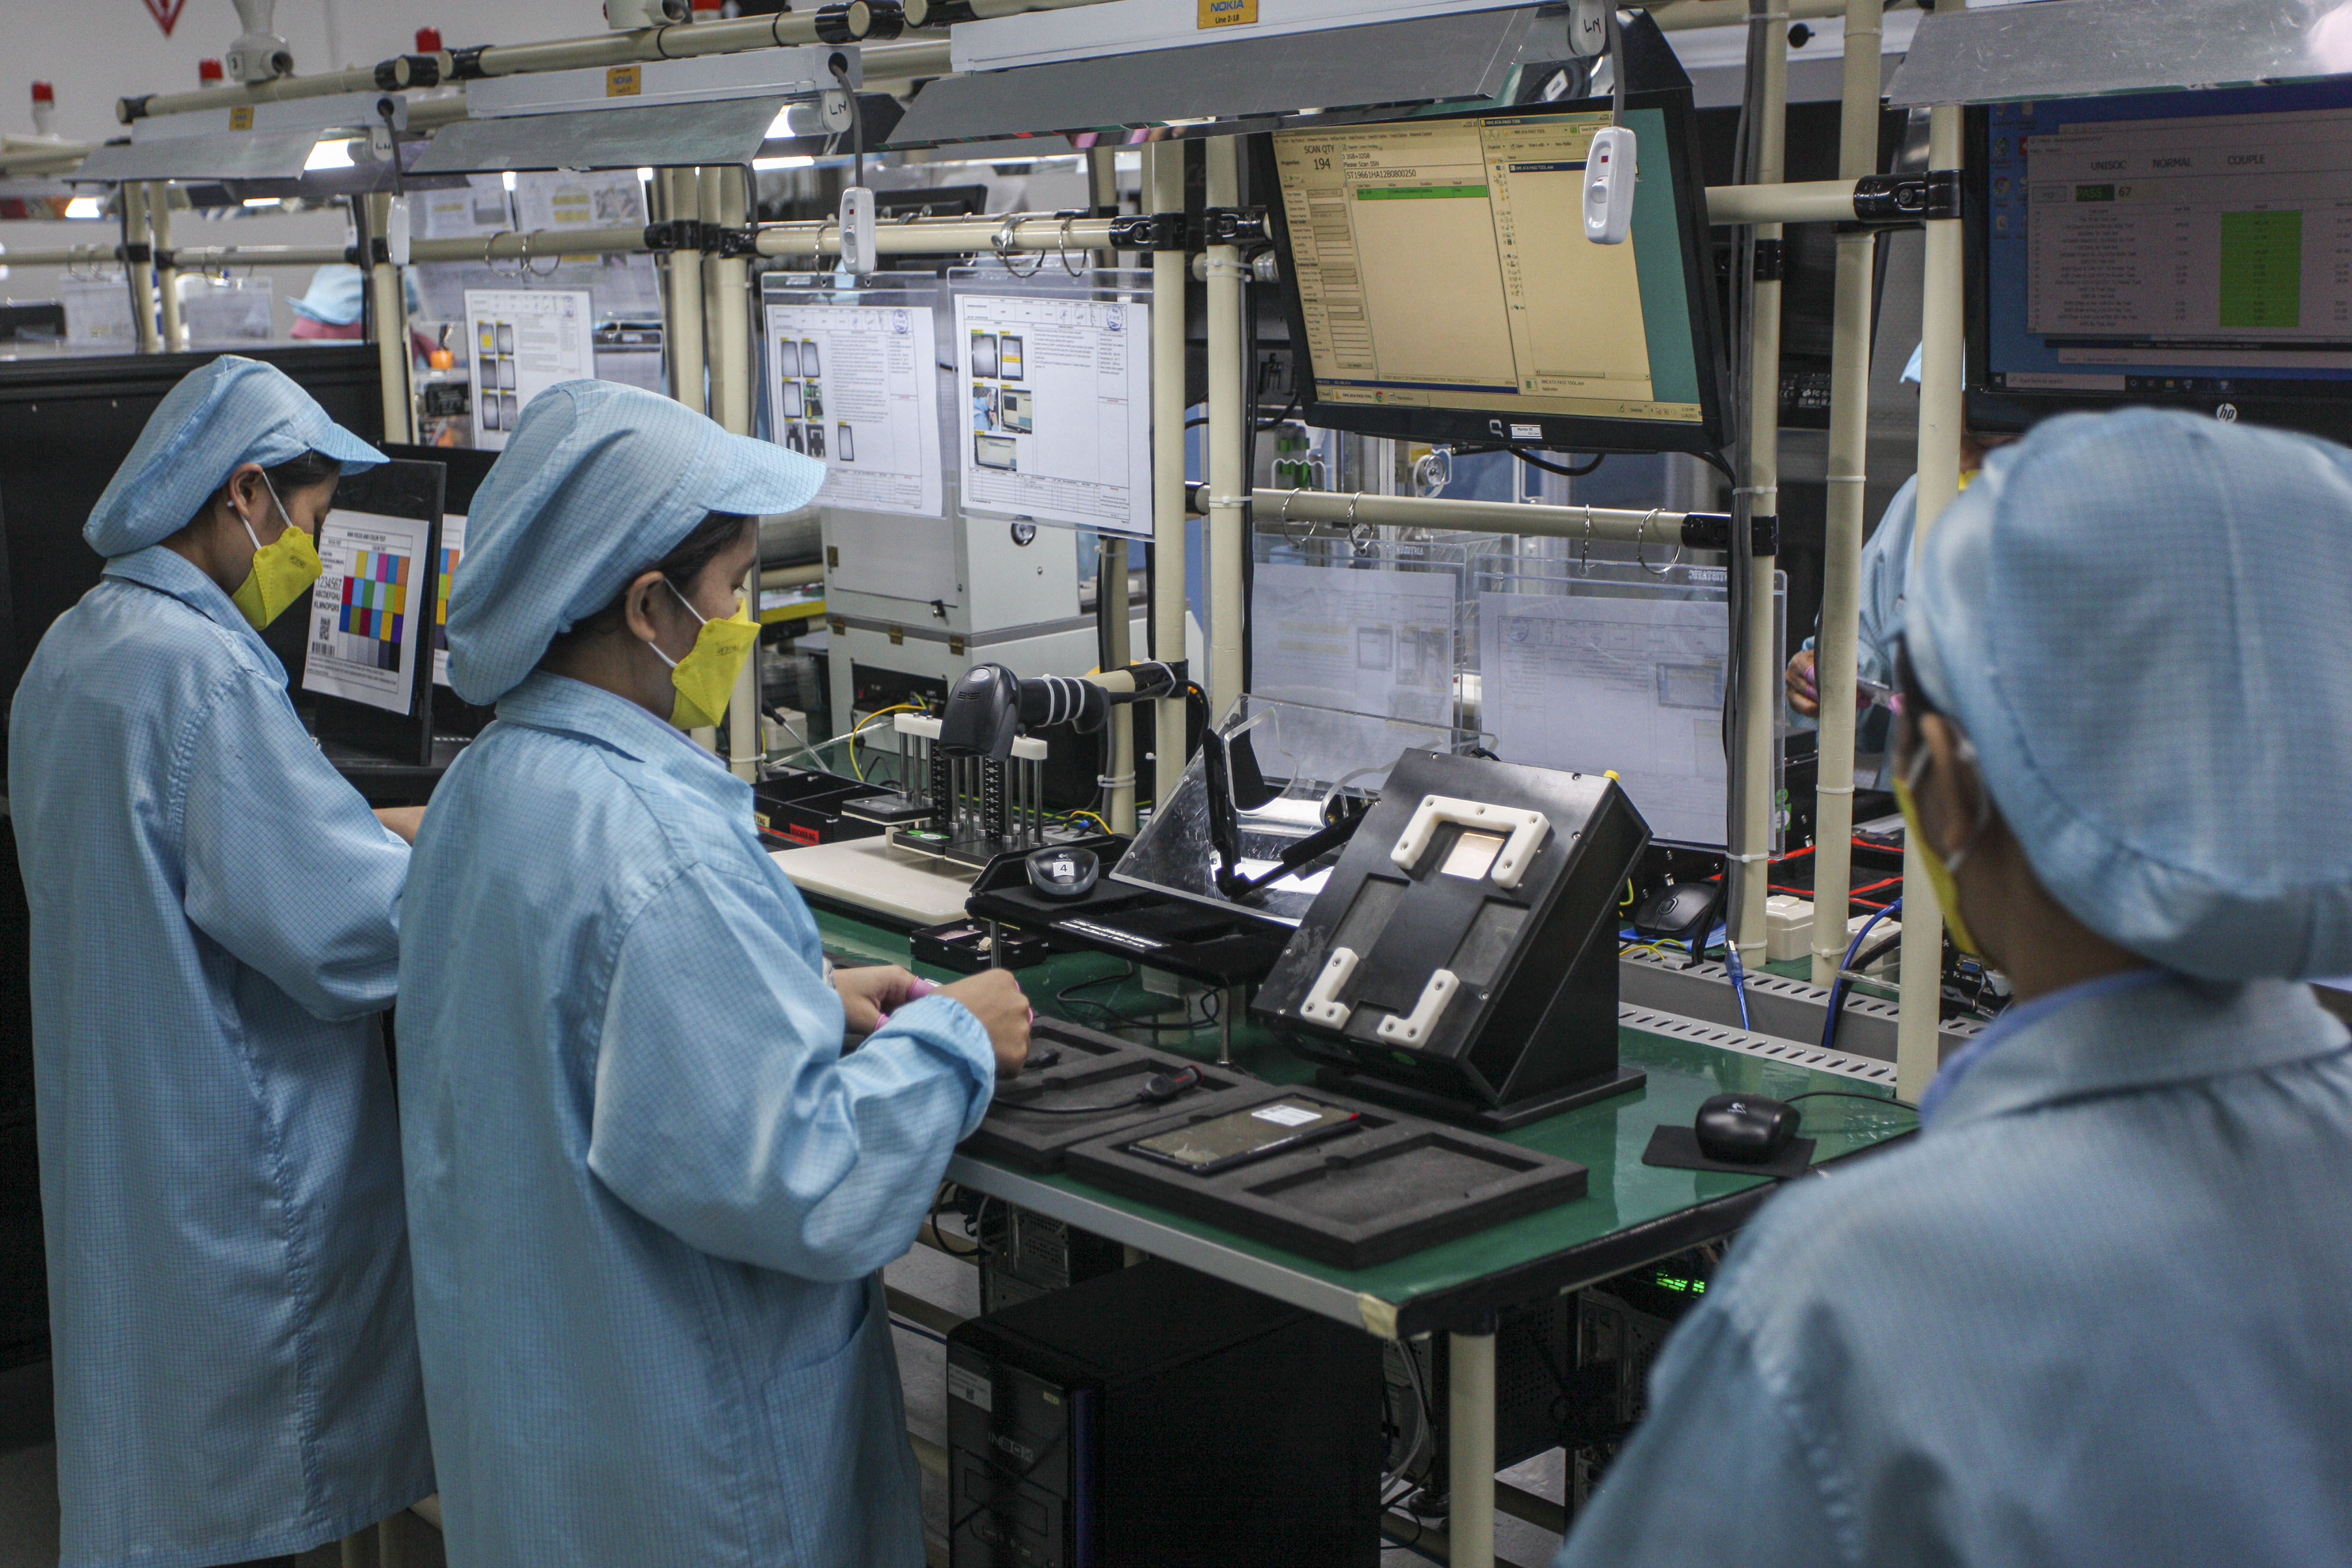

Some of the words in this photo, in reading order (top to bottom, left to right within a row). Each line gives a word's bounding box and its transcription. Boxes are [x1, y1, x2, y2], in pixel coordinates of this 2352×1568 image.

[1211, 0, 1244, 12] NOKIA
[1215, 15, 1227, 24] Line
[1227, 14, 1240, 22] 2-18
[1304, 145, 1321, 153] SCAN
[1322, 145, 1335, 154] QTY
[1314, 158, 1331, 170] 194
[2090, 160, 2127, 170] UNISOC
[2152, 158, 2191, 168] NORMAL
[2227, 154, 2266, 165] COUPLE
[2077, 186, 2103, 199] PASS
[2119, 187, 2132, 197] 67
[2219, 403, 2235, 422] hp
[757, 816, 766, 825] TAG
[1060, 864, 1067, 872] 4
